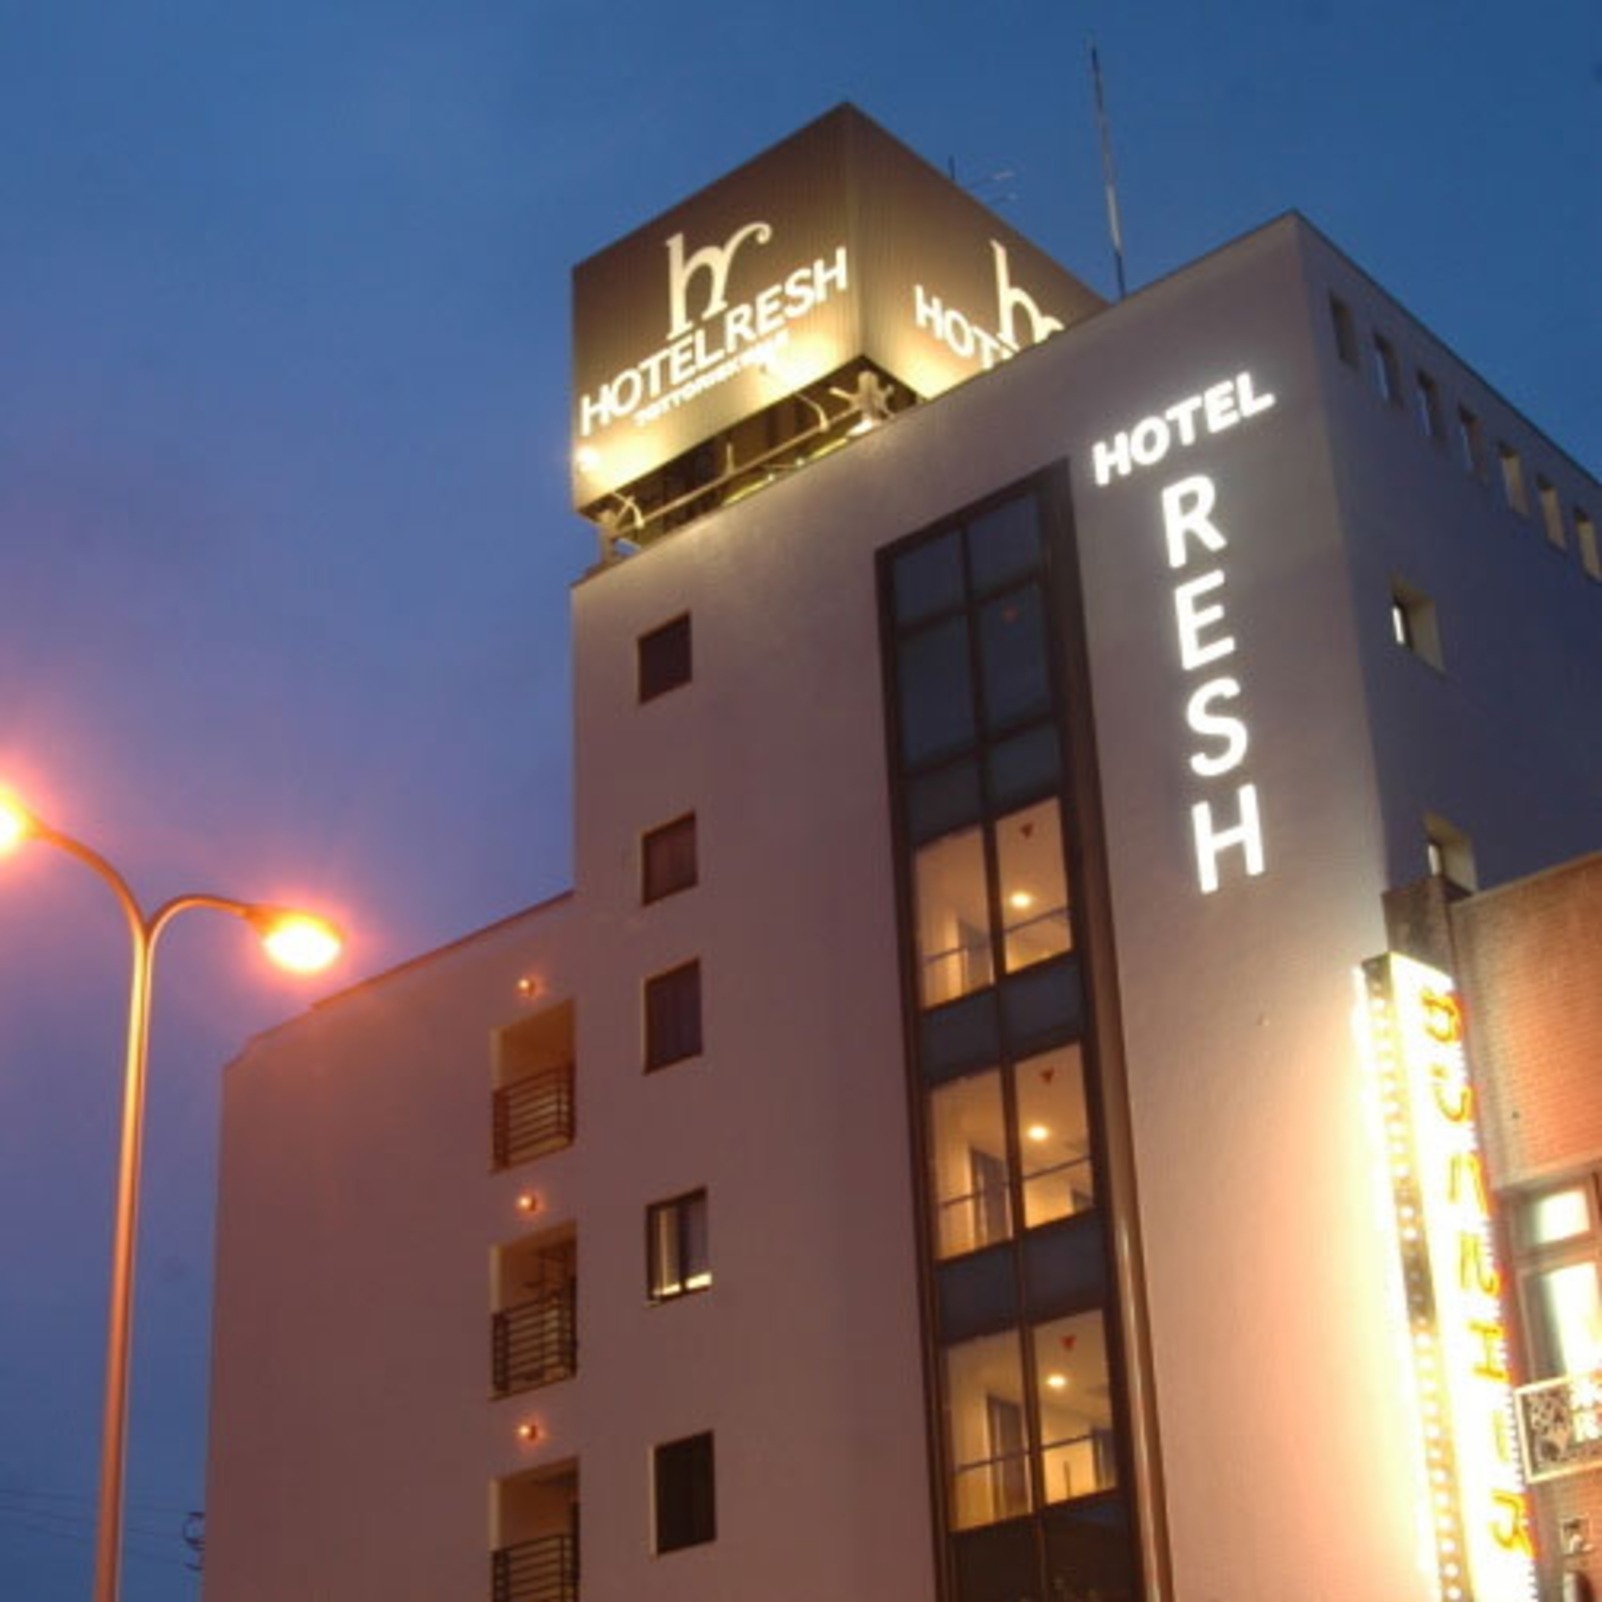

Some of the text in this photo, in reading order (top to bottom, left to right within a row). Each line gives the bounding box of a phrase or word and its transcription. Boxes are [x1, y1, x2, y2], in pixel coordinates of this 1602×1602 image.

[579, 328, 726, 437] HOTEL
[724, 246, 847, 354] RESH
[914, 283, 1014, 370] HOT
[1092, 371, 1276, 486] HOTEL
[1160, 473, 1266, 894] RESH
